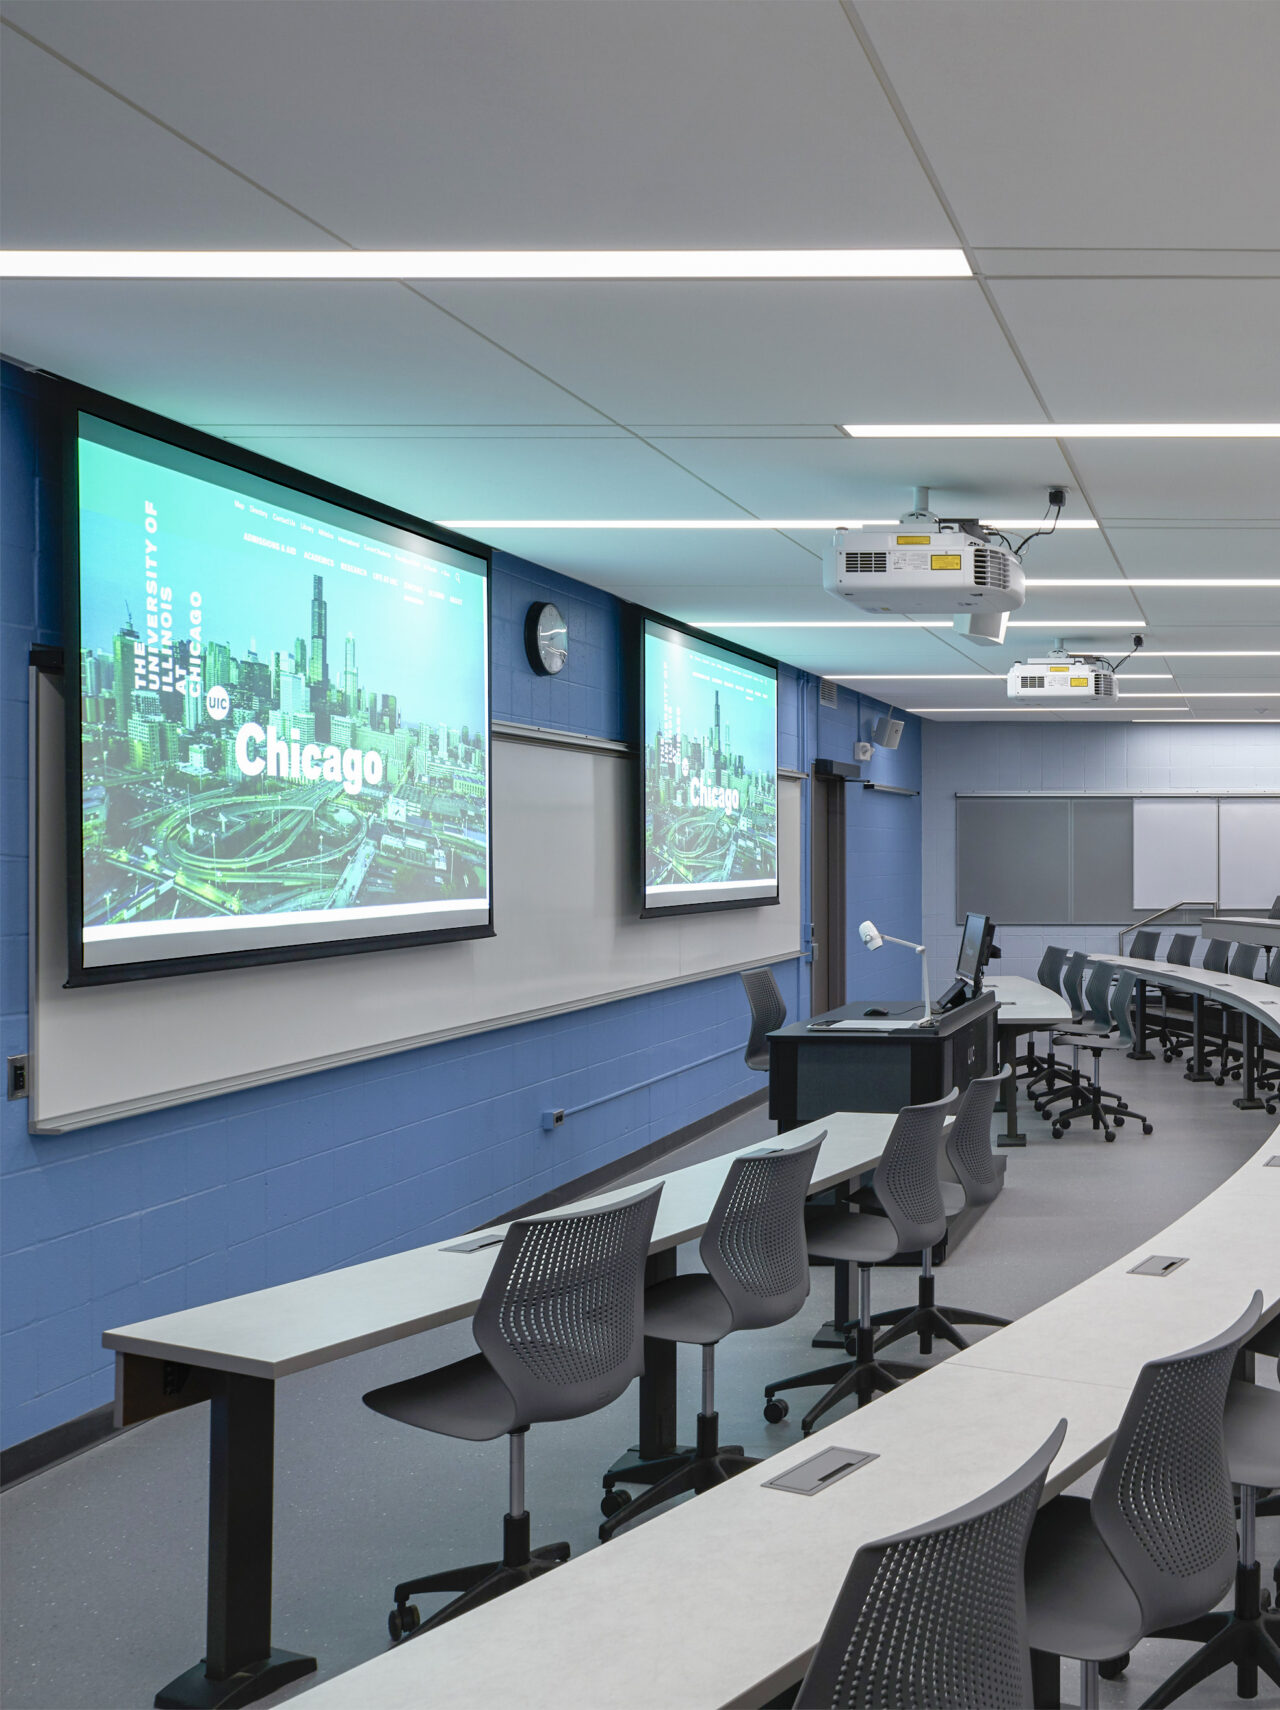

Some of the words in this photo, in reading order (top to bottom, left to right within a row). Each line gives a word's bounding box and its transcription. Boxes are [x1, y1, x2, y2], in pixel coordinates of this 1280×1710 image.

[144, 500, 158, 534] OF
[145, 539, 160, 691] UNIVERSITY
[160, 586, 174, 693] ILLINOIS
[134, 641, 147, 690] THE
[189, 591, 203, 698] CHICAGO
[175, 665, 187, 695] AT
[208, 696, 227, 710] UIC
[235, 722, 383, 795] Chicago
[690, 777, 739, 815] Chicago
